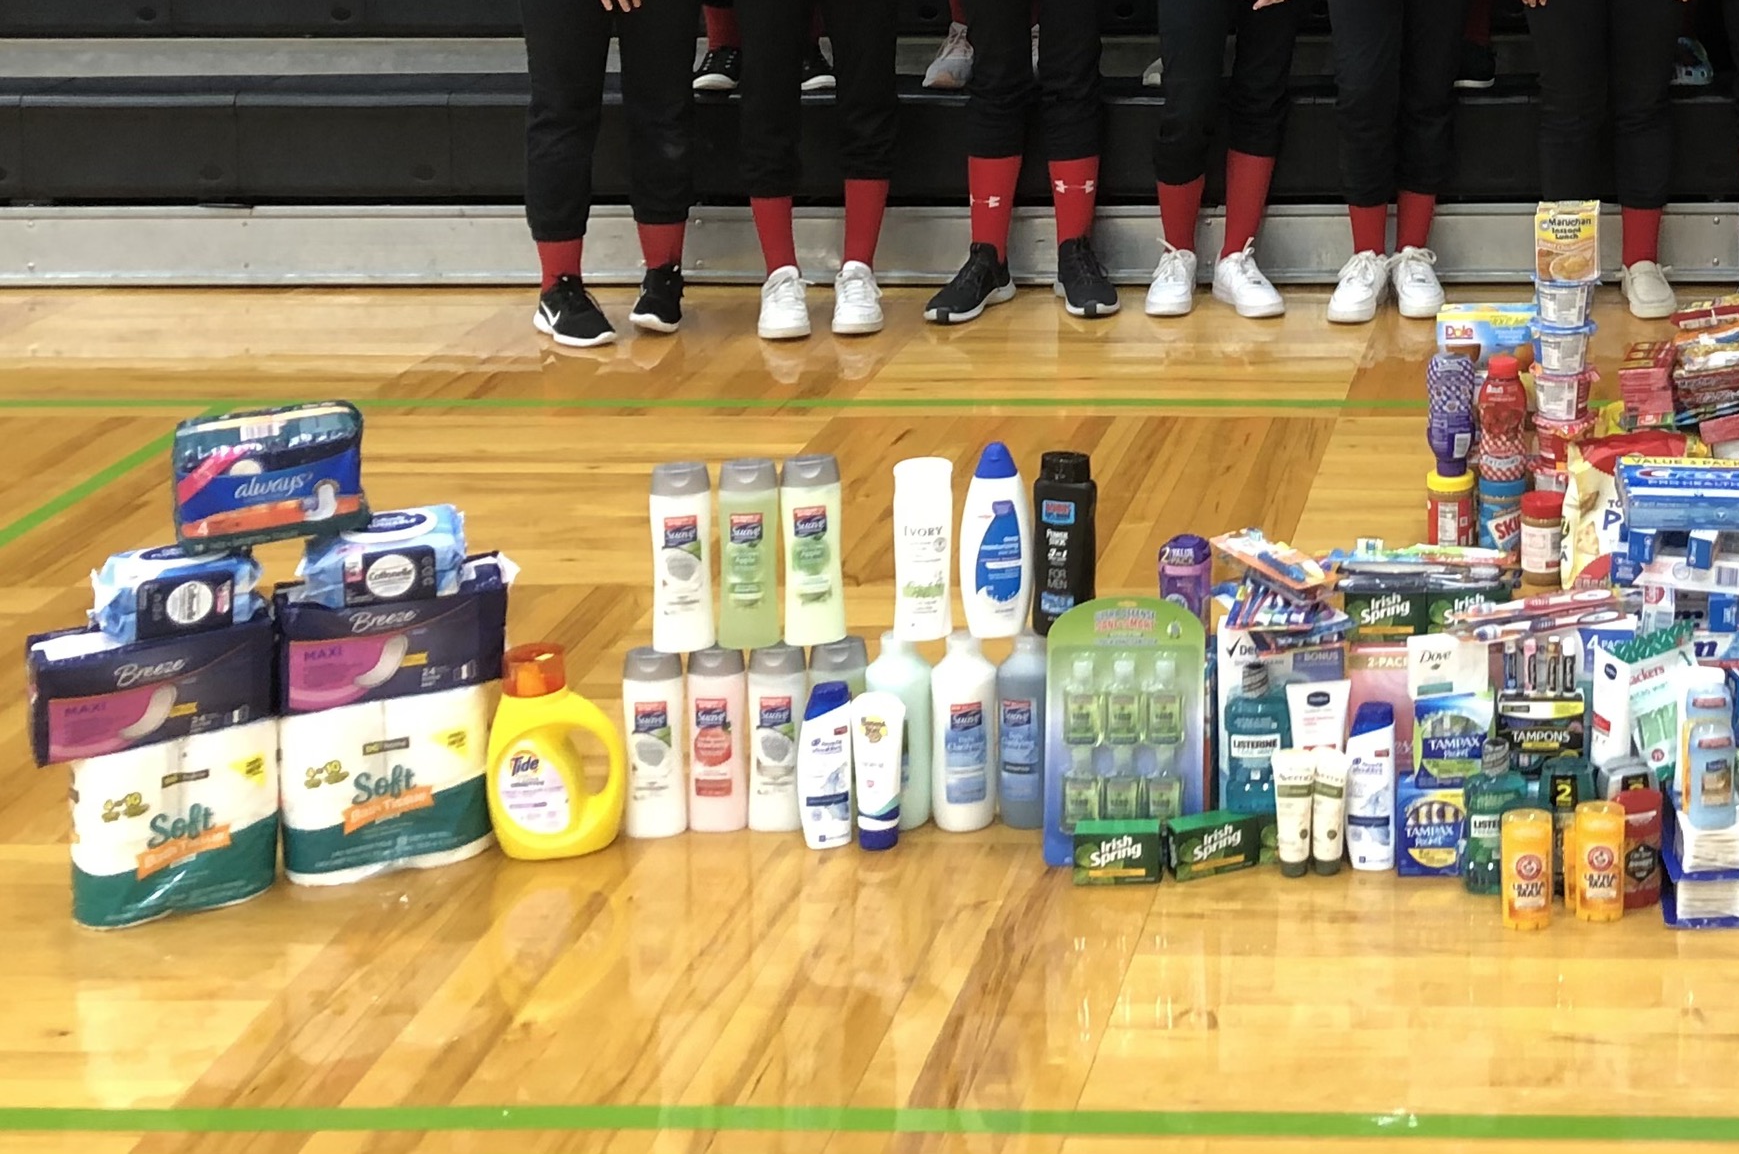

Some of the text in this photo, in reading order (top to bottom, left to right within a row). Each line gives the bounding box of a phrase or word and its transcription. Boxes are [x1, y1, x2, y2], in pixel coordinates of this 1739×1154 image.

[1549, 218, 1592, 227] Maruchan
[1445, 325, 1474, 339] Dole
[1632, 457, 1683, 465] VALUE
[234, 473, 313, 499] always
[904, 525, 943, 538] IVORY
[1161, 546, 1195, 564] 2 VALUE
[1171, 557, 1195, 565] PACK
[1048, 569, 1067, 579] FOR
[1371, 593, 1401, 612] Irish
[1454, 593, 1485, 612] Irish
[1361, 599, 1411, 625] Spring
[349, 609, 416, 634] Breeze
[1587, 635, 1599, 648] 4
[304, 647, 342, 662] MAXI
[1303, 651, 1339, 662] BONUS
[1420, 650, 1451, 664] Dove
[114, 658, 186, 688] Breeze
[1629, 664, 1666, 686] ackers
[65, 702, 106, 717] MAXI
[1233, 738, 1278, 749] LISTERINE
[1429, 736, 1480, 750] TAMPAX
[1511, 730, 1571, 744] TAMPONS
[510, 756, 540, 777] Tide
[352, 764, 417, 805] Soft
[1557, 785, 1573, 803] 2
[147, 803, 215, 849] Soft
[1203, 824, 1234, 846] Irish
[1405, 825, 1454, 838] TAMPAX
[1101, 835, 1132, 855] Irish
[1193, 829, 1243, 862] Spring
[1090, 843, 1142, 869] Spring
